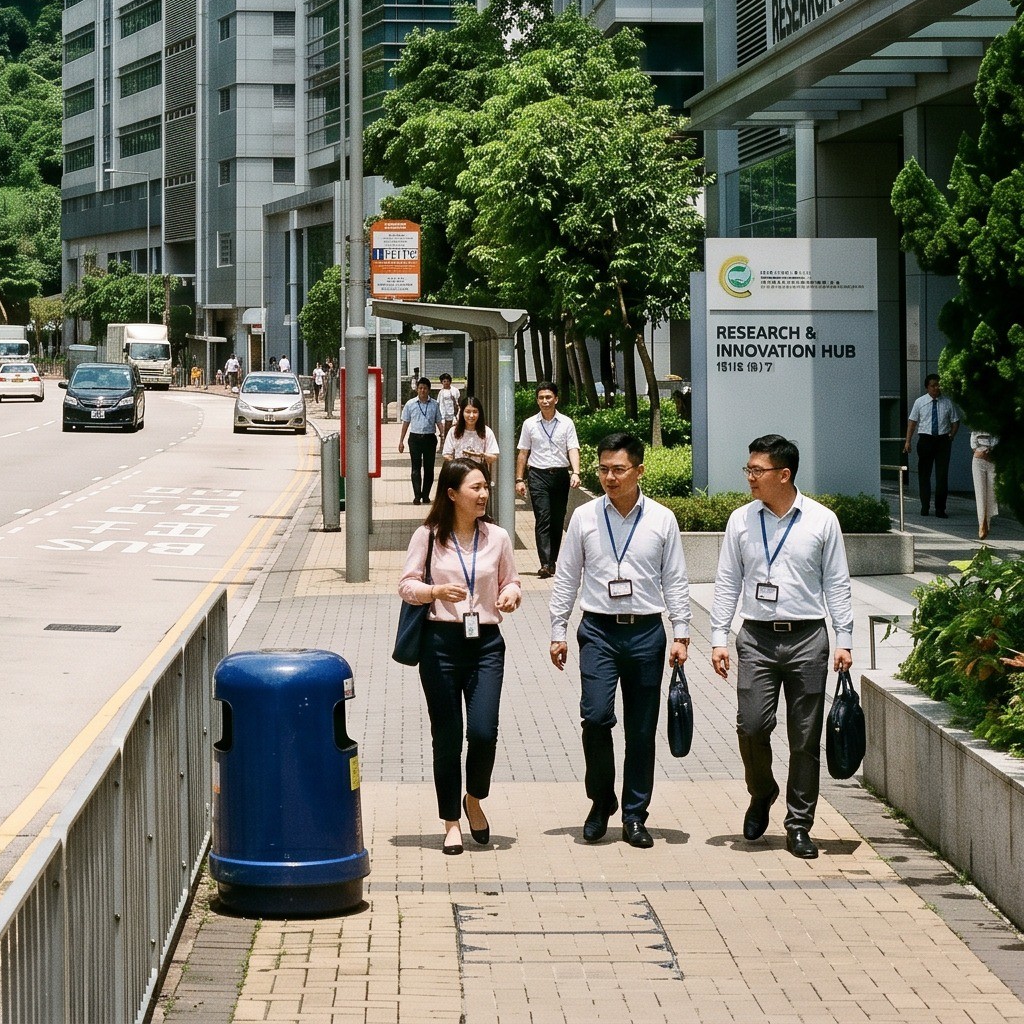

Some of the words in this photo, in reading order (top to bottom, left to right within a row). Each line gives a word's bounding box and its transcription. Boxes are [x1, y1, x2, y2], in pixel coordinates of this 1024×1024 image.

[716, 326, 800, 340] RESEARCH
[805, 326, 817, 340] &
[716, 344, 816, 358] INNOVATION
[821, 344, 856, 358] HUB
[34, 538, 205, 556] BUS
